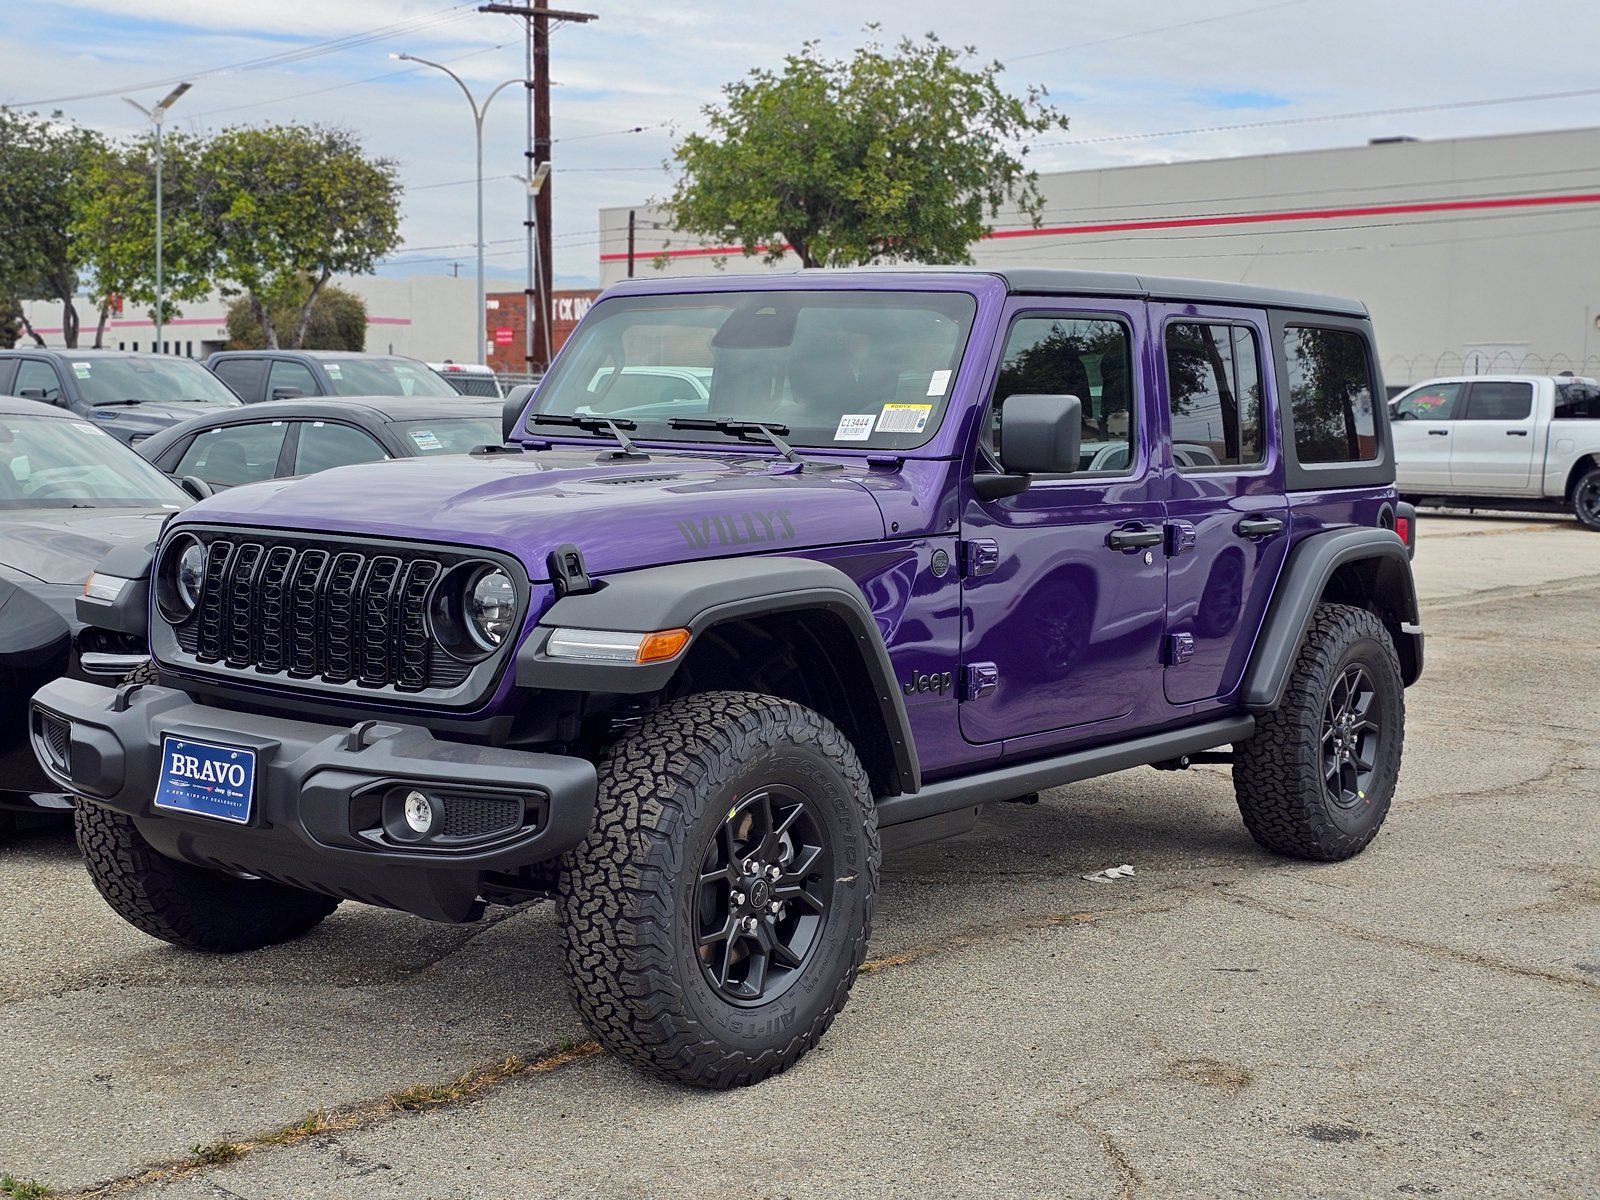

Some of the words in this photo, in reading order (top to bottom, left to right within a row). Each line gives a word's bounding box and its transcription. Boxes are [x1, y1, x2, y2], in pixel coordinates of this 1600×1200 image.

[674, 509, 796, 549] WILLYS
[903, 669, 952, 696] Jeep
[170, 753, 245, 786] BRAVO
